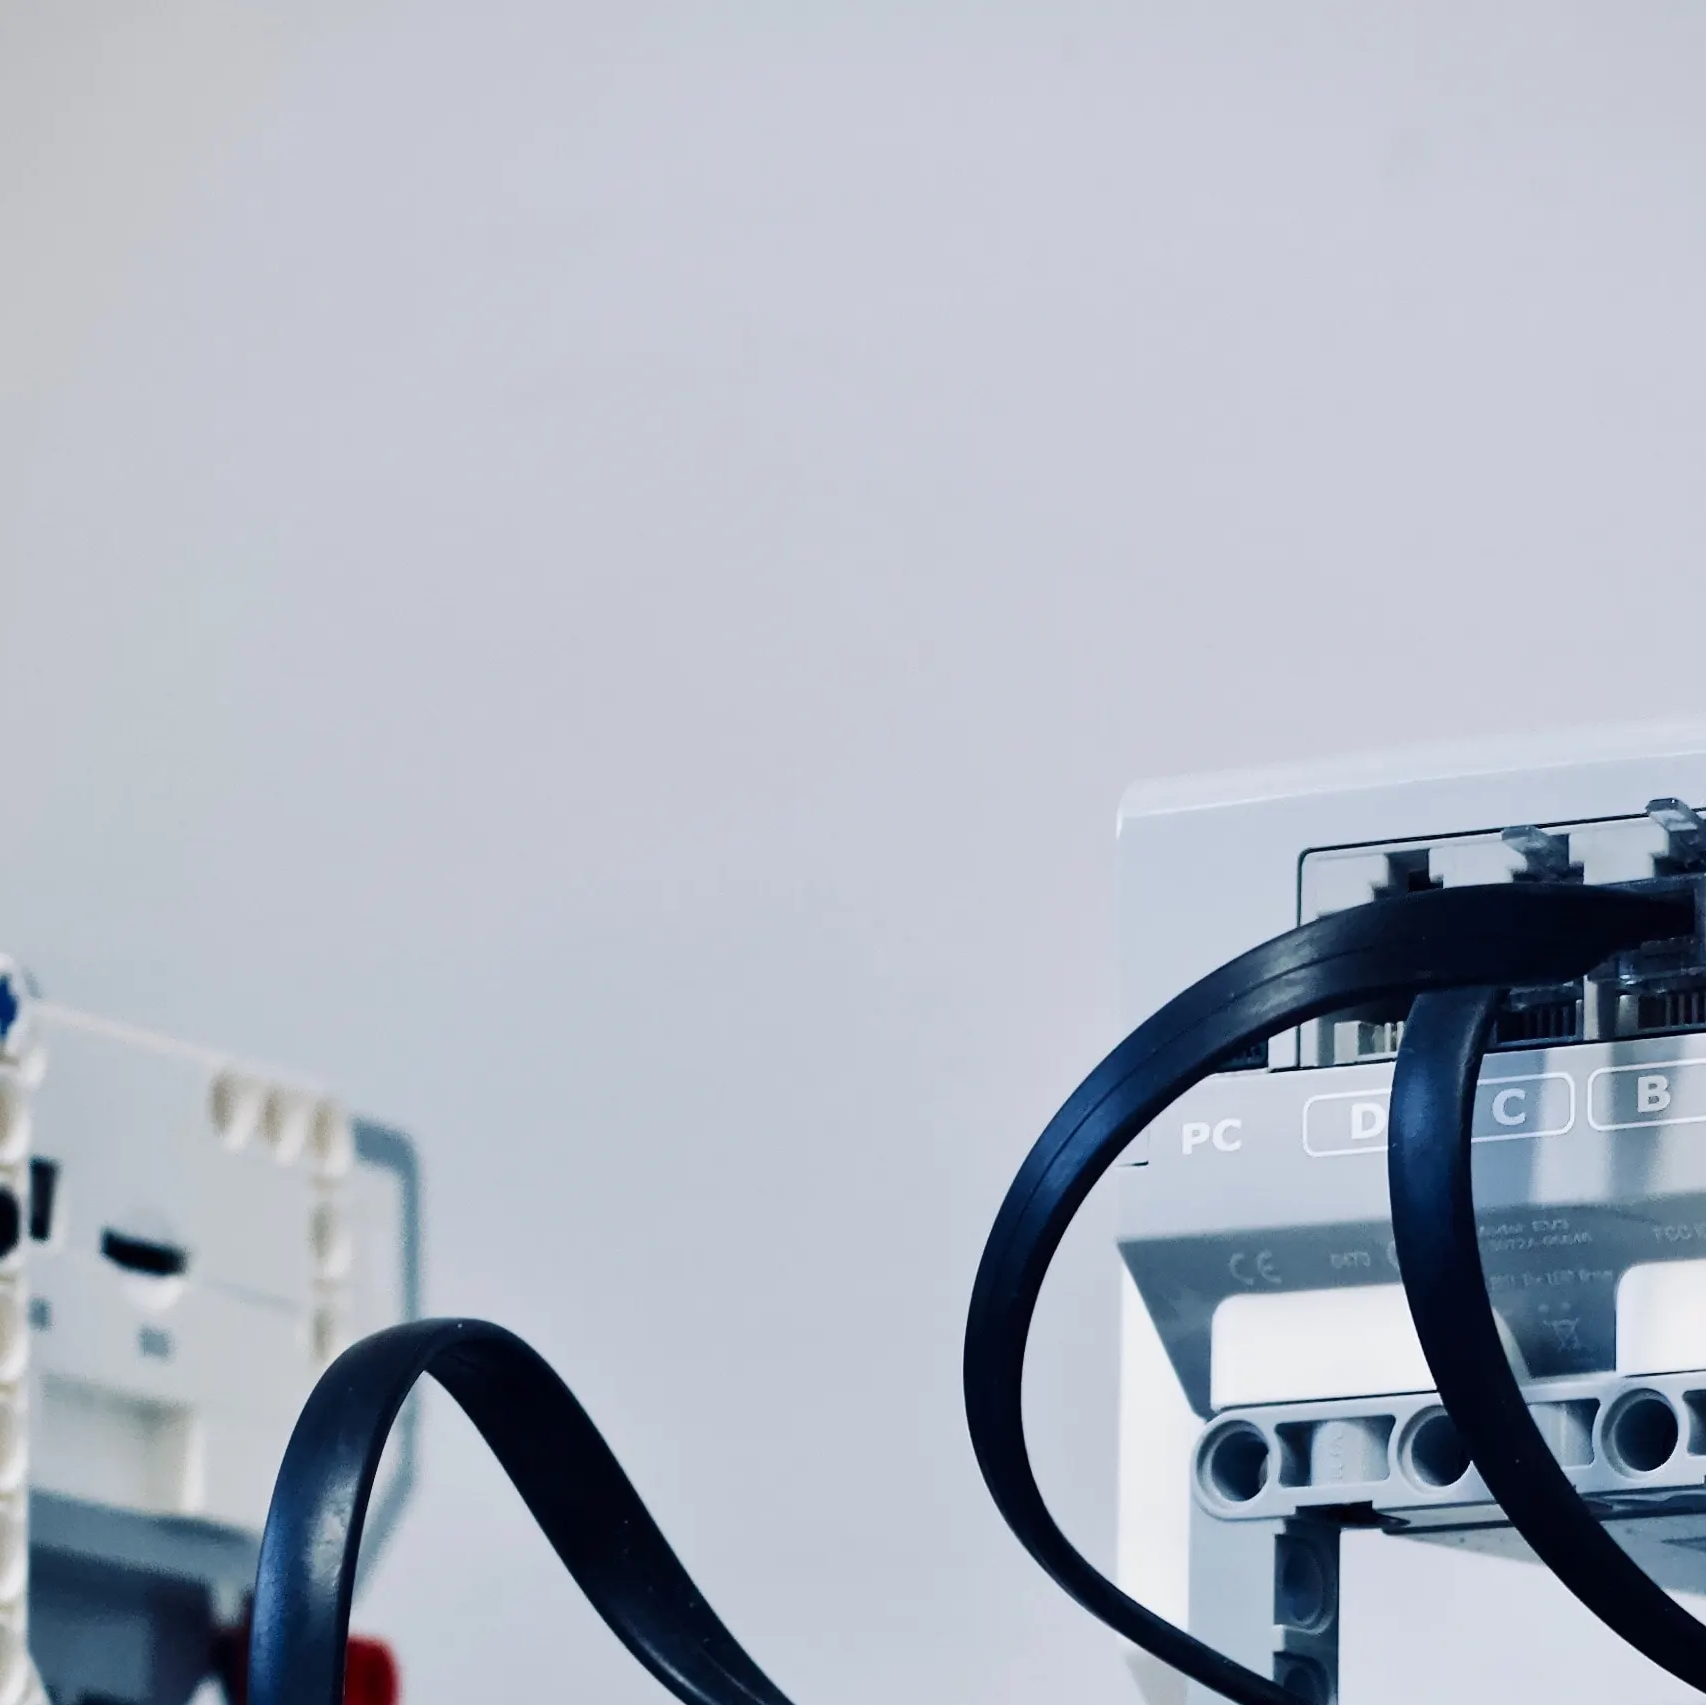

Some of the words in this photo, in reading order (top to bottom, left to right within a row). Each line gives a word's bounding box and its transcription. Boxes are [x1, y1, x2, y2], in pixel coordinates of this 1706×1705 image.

[1181, 1118, 1243, 1155] PC
[1352, 1104, 1386, 1139] D
[1492, 1088, 1526, 1126] C
[1636, 1075, 1671, 1113] B
